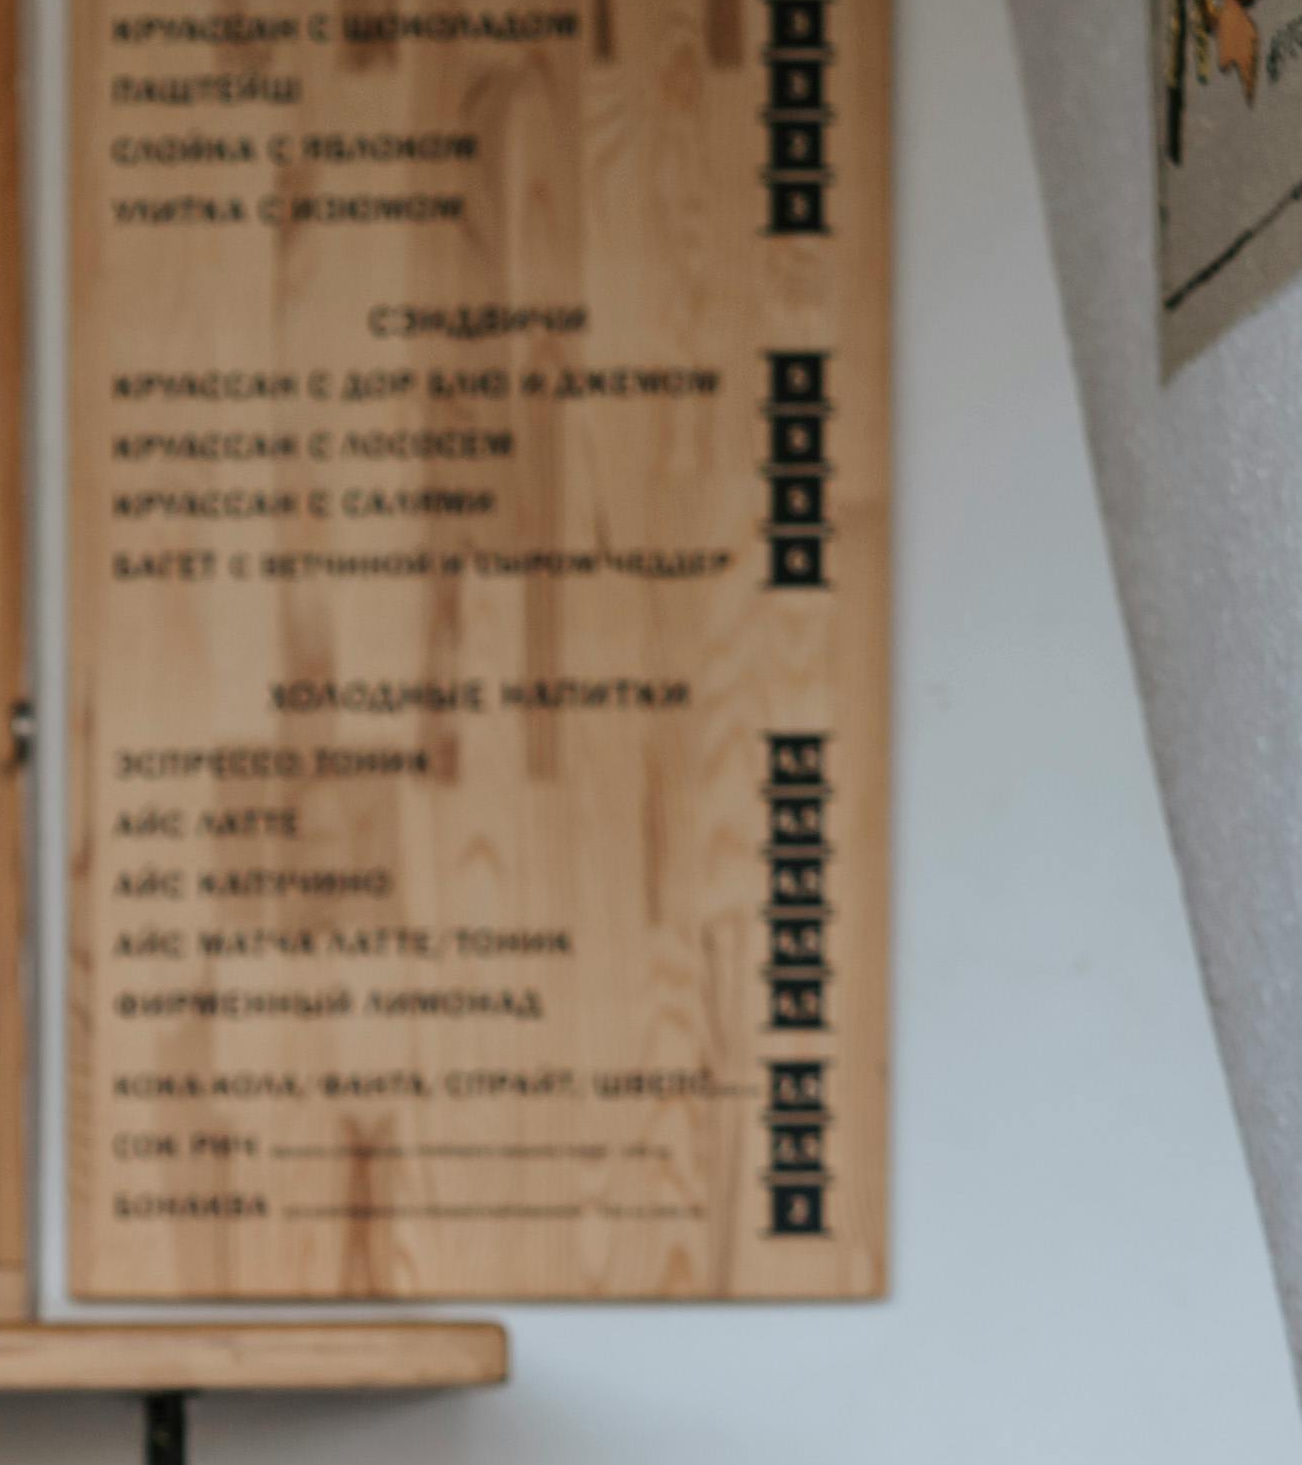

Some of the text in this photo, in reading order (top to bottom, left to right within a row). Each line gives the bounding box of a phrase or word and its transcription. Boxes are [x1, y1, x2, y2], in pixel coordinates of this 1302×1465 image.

[112, 8, 581, 47] КРУАССАН С ШОКОЛАДОМ
[112, 68, 302, 109] ПАШТЕЙШ
[112, 128, 480, 169] СЛОЙКА С ЯБЛОКОМ
[112, 191, 467, 229] УЛИТКА С ИЗЮМОМ
[369, 304, 591, 343] СЭНДВИЧИ
[112, 367, 724, 405] КРУАССАН С ДОР БЛЮ И ДЖЕМОМ
[112, 428, 519, 463] КРУАССАН С ЛОСОСЕМ
[112, 487, 497, 522] КРУАССАН С САЛЯМИ
[112, 543, 737, 583] БАГЕТ С ВЕТЧИНОЙ И СЫРОМ ЧЕДДЕР
[268, 677, 694, 717] ХОЛОДНЫЕ НАПИТКИ
[111, 747, 436, 781] ЭСПРЕССО ТОНИК
[112, 803, 306, 841] АЙС ЛАТТЕ
[112, 861, 396, 902] АЙС КАПУЧИНО
[112, 923, 188, 961] АЙС
[195, 928, 320, 961] МАТЧА
[112, 981, 548, 1023] ФИРМЕННЫЙ ЛИМОНАД
[112, 1131, 183, 1166] СОК
[191, 1131, 263, 1166] РИЧ
[112, 1190, 273, 1225] БОНАКВА
